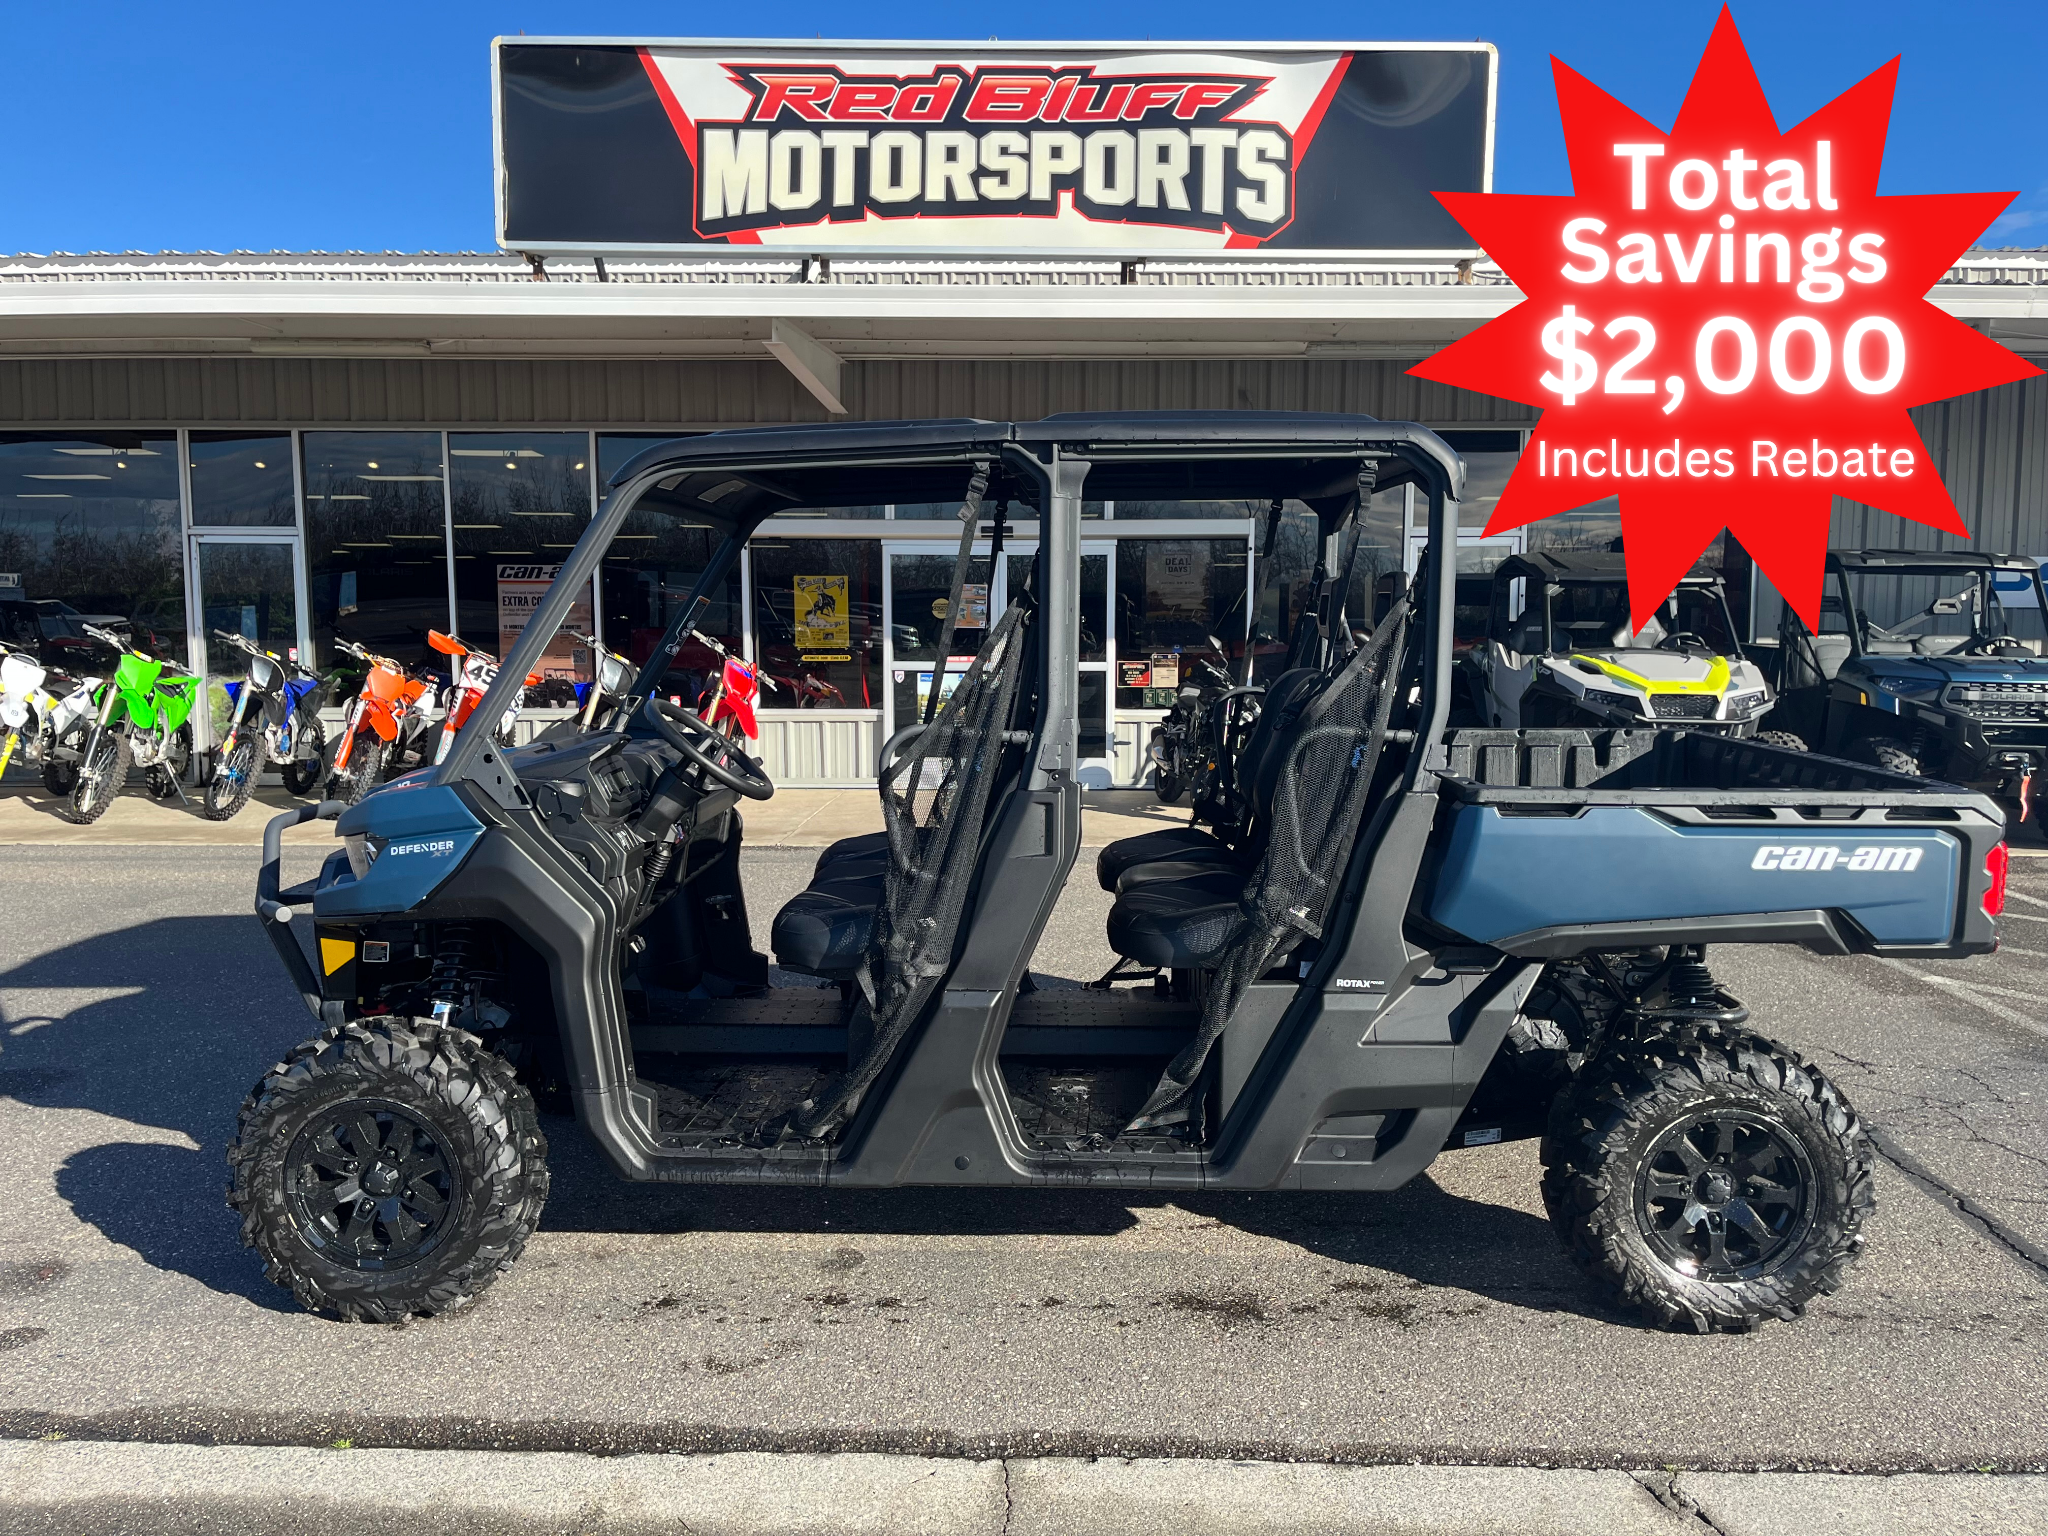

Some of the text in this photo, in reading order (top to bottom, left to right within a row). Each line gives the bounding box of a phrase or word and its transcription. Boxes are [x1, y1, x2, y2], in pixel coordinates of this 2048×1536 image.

[752, 74, 963, 122] Red
[703, 128, 1286, 223] MOTORSPORTS
[499, 565, 562, 579] can-a
[502, 596, 545, 607] EXTRA CO
[1980, 692, 2033, 701] POLARIS
[390, 840, 454, 856] DEFENDER
[430, 849, 453, 858] XT
[1751, 845, 1925, 872] can-am
[1336, 979, 1371, 988] ROTAX
